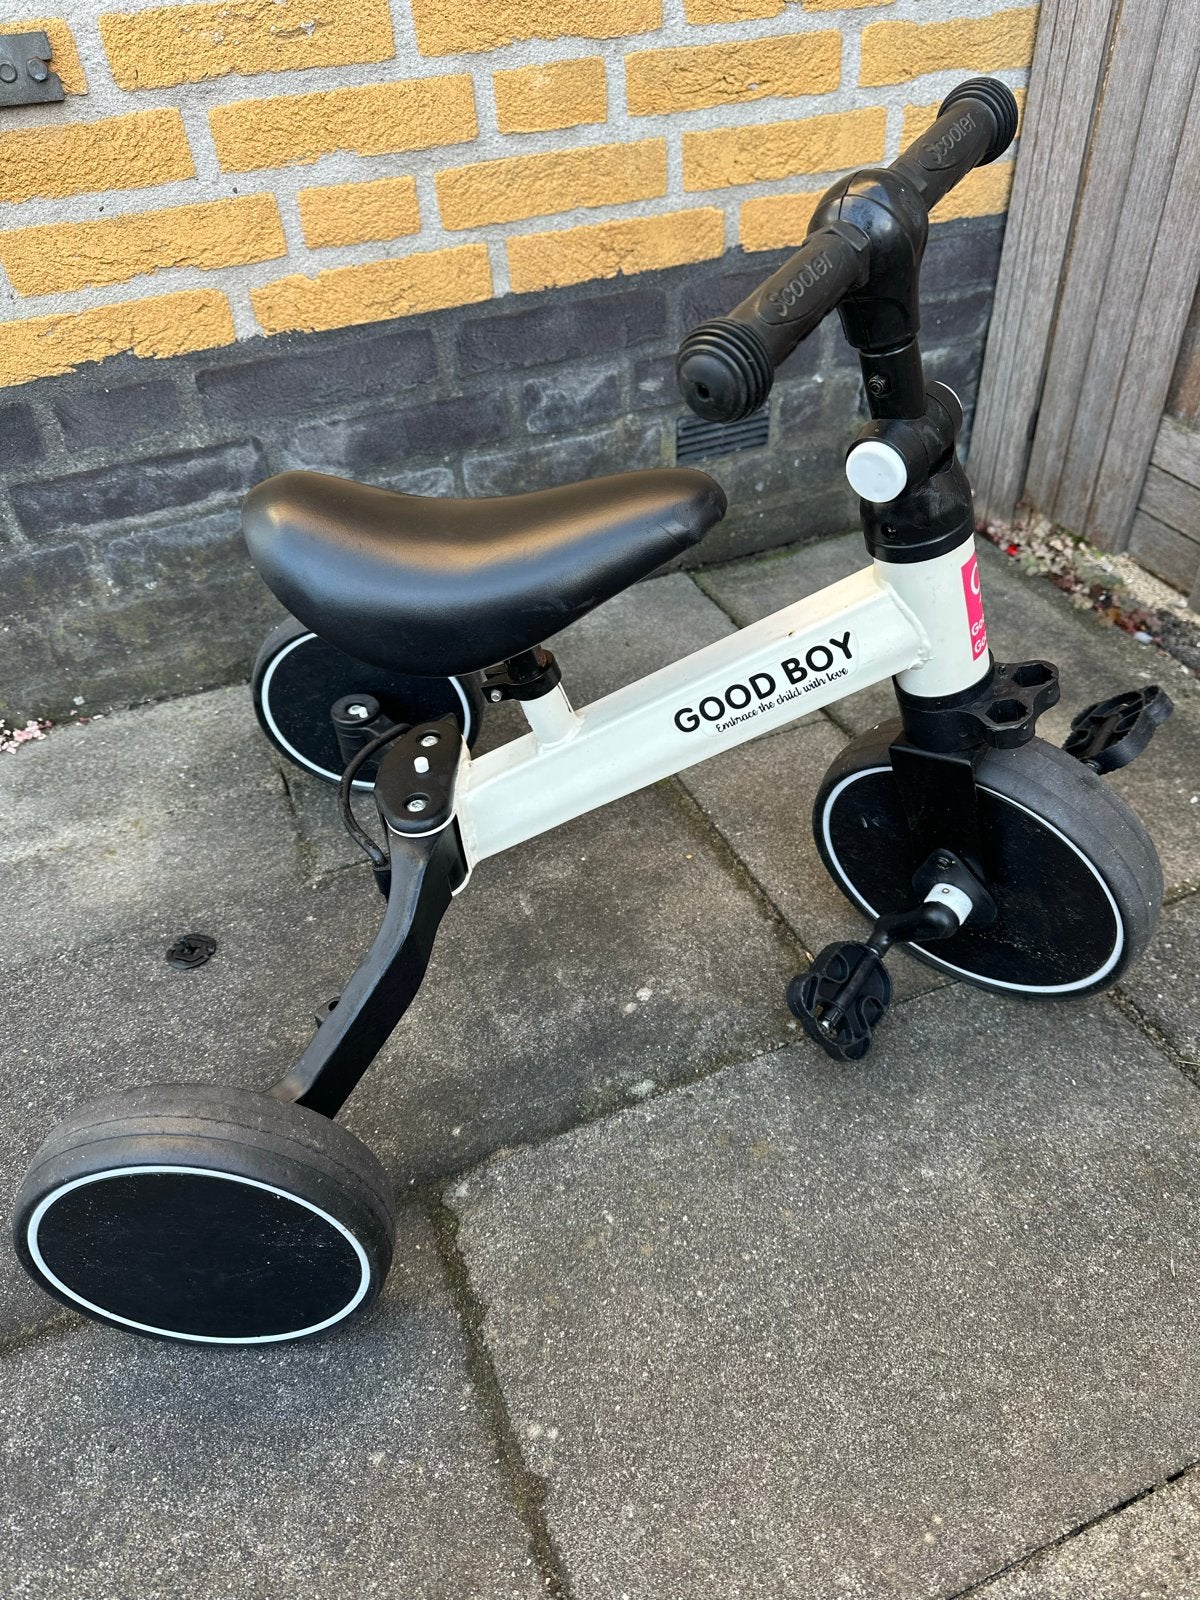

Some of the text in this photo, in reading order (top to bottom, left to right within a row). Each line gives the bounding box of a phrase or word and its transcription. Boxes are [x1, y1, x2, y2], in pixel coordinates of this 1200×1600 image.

[922, 112, 977, 165] Scooter
[767, 251, 833, 317] Scooter
[674, 631, 853, 733] GOOD BOY
[715, 667, 849, 732] Embrace the child with love
